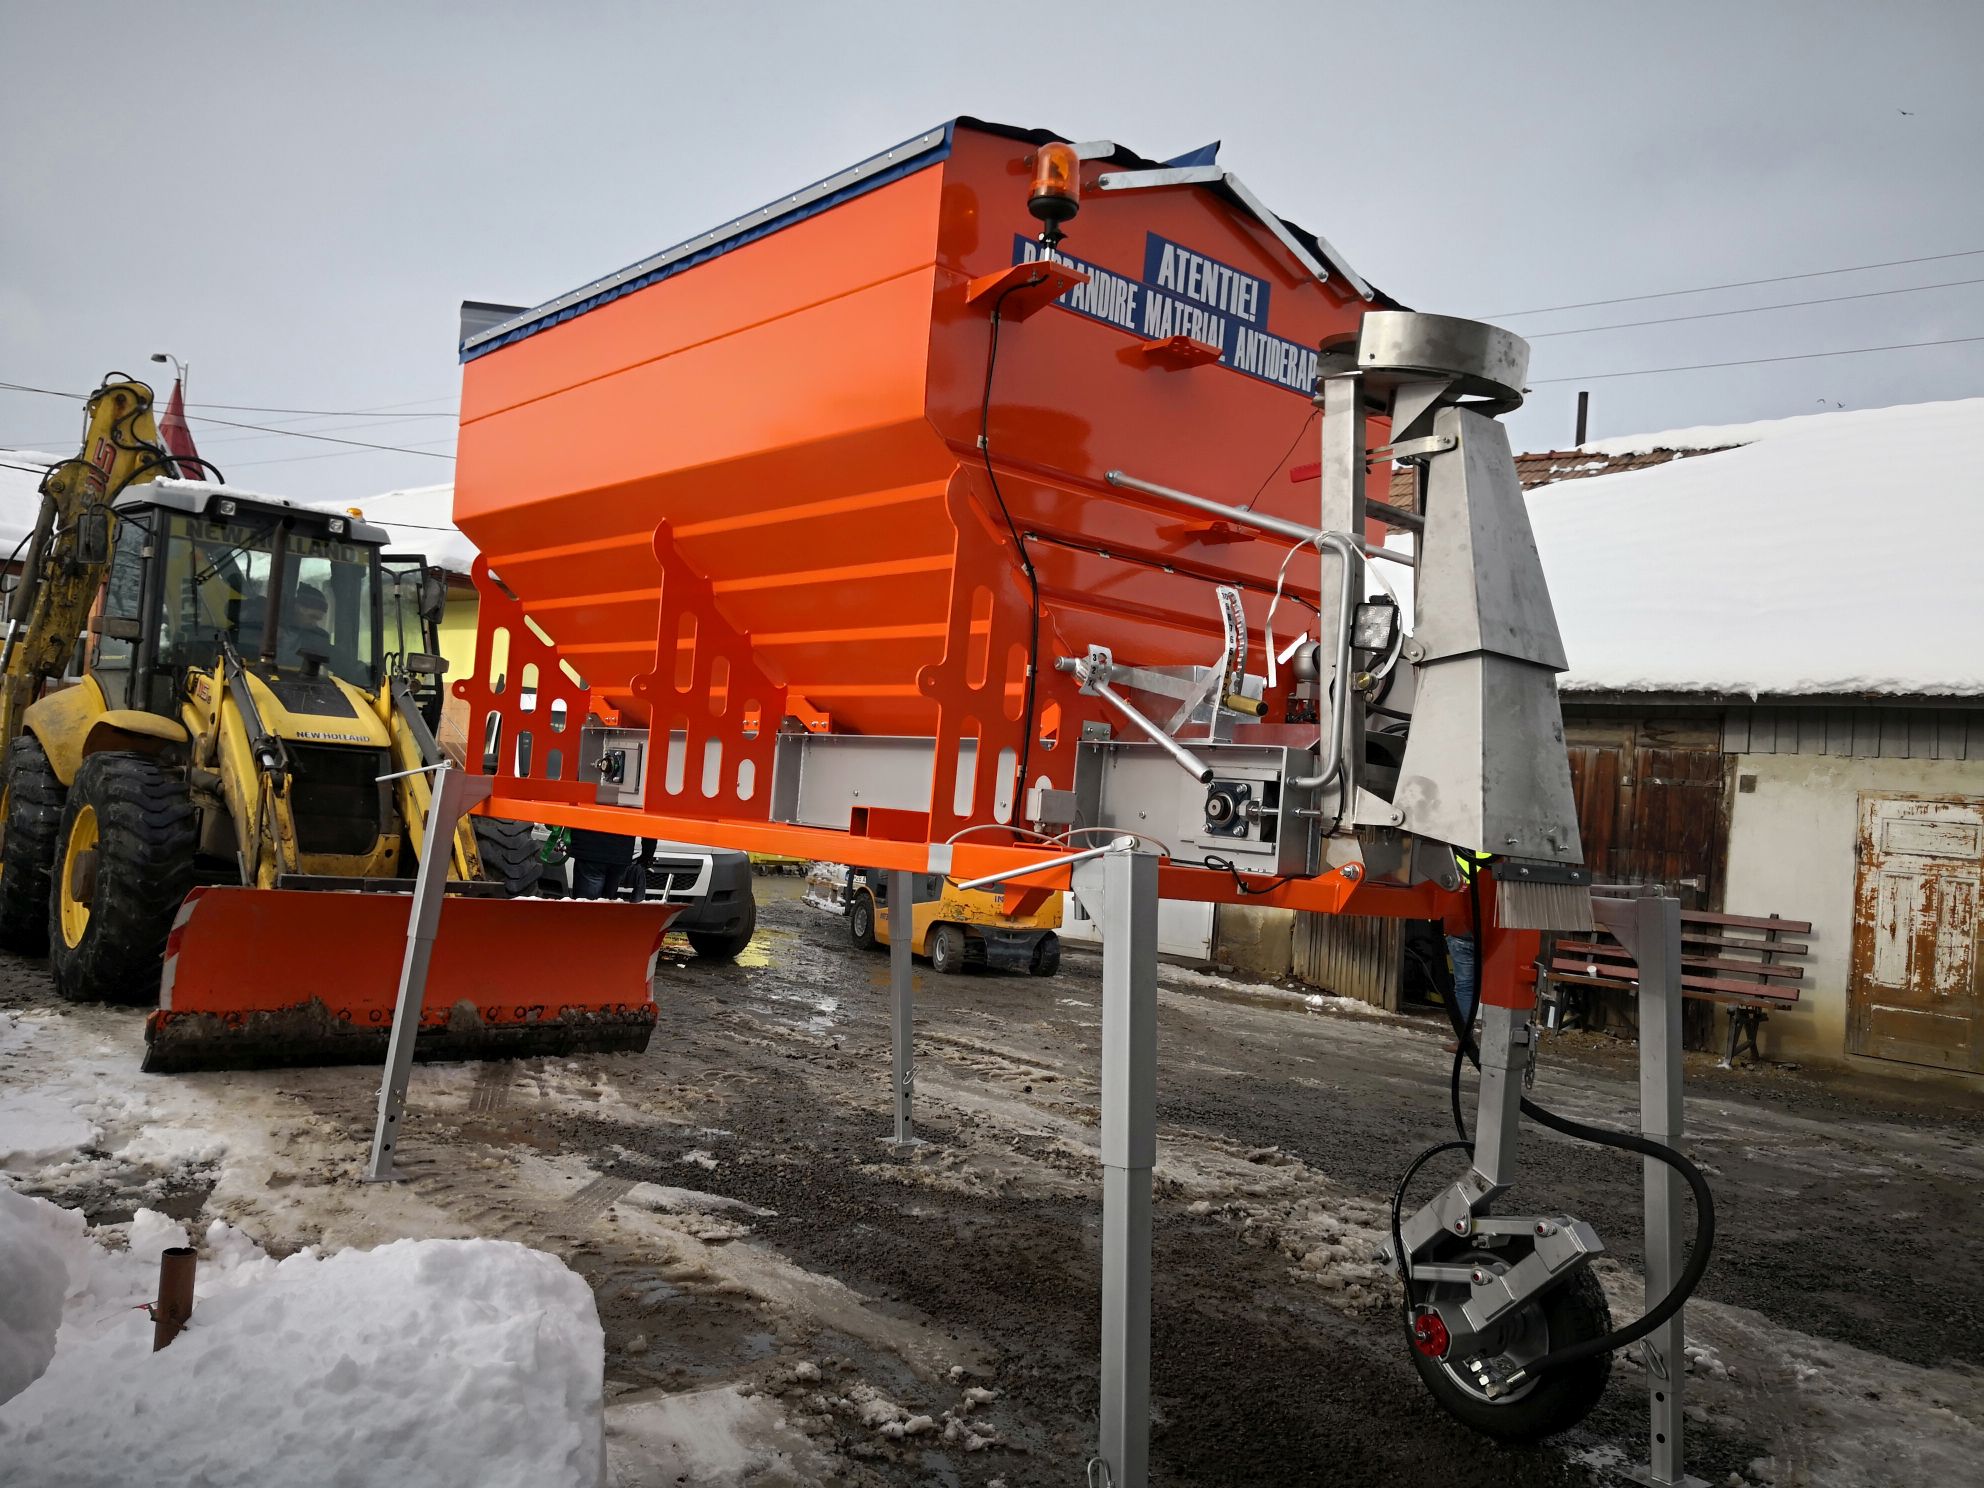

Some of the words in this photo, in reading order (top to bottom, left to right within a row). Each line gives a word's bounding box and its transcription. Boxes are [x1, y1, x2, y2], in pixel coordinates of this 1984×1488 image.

[1157, 243, 1259, 322] ATENTIE!
[1024, 241, 1138, 329] ANDIRE
[1234, 326, 1320, 394] ANTIDERAP
[186, 519, 245, 544] NEW
[296, 731, 321, 739] NEW
[323, 733, 371, 742] HOLLAND
